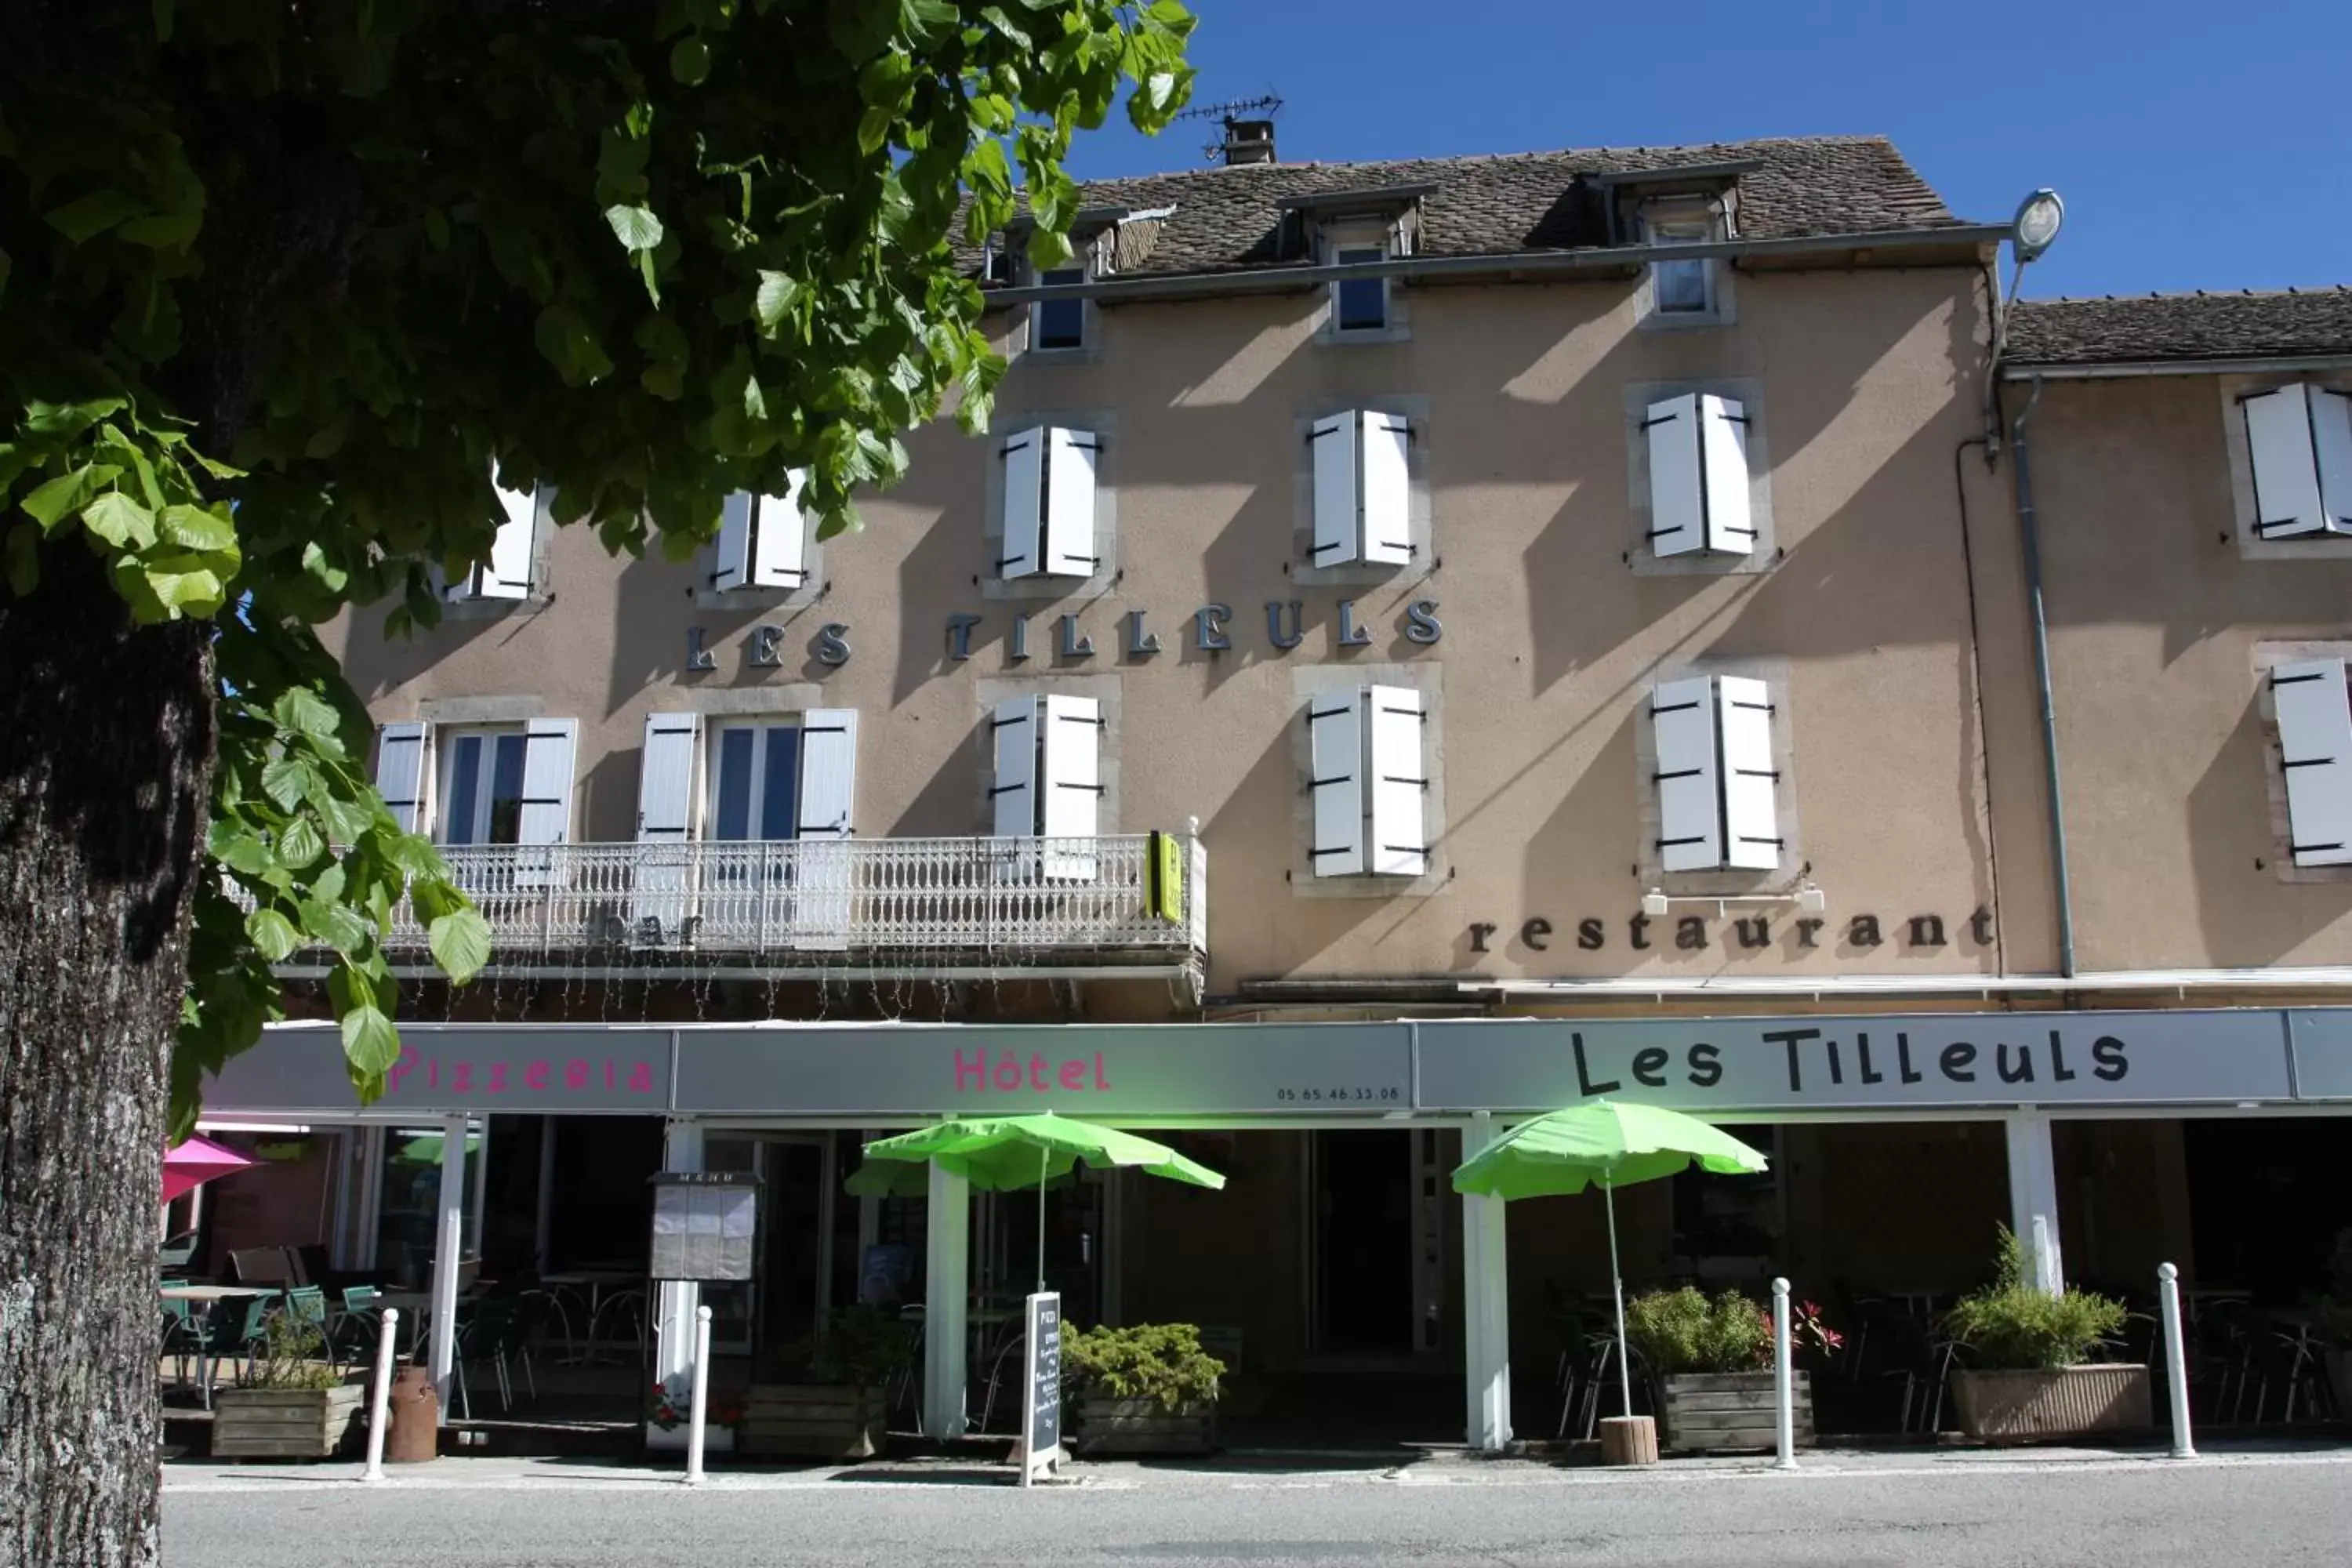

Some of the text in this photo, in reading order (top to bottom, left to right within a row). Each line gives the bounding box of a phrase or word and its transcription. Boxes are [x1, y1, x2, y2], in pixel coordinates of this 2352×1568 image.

[687, 599, 1443, 670] LES TILLEULS
[1469, 903, 1994, 953] restaurant
[953, 1047, 1112, 1093] Hôtel
[1571, 1027, 2129, 1097] Les Tilleuls
